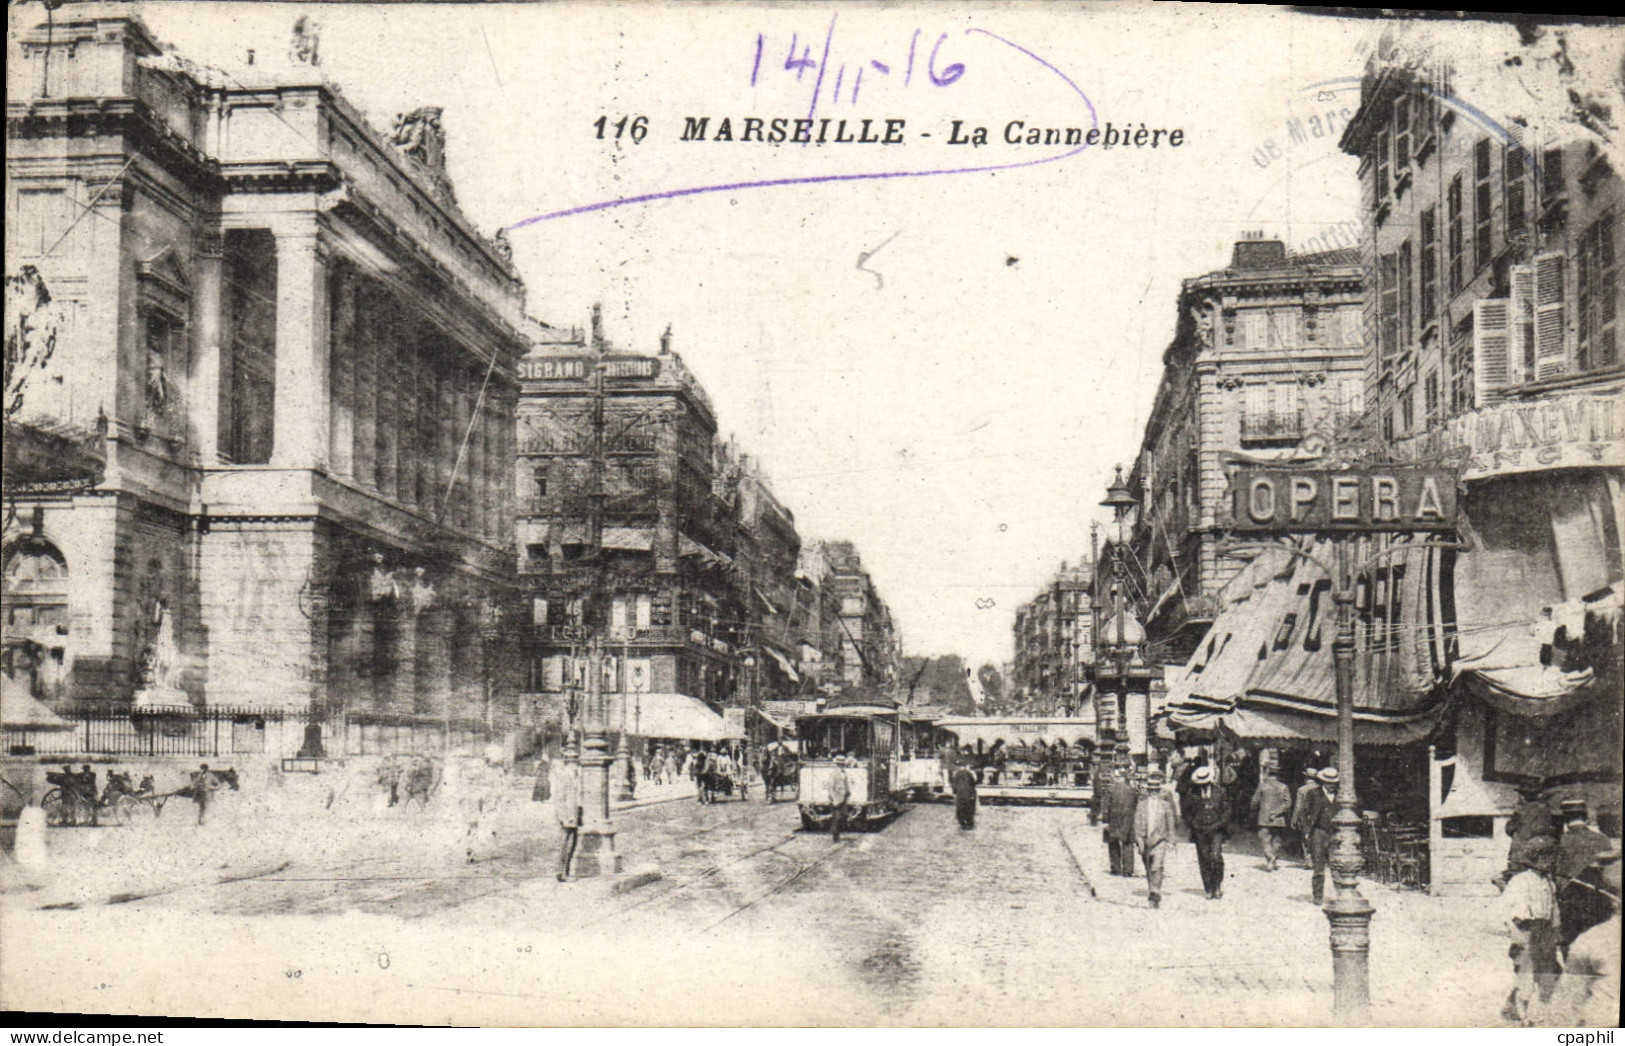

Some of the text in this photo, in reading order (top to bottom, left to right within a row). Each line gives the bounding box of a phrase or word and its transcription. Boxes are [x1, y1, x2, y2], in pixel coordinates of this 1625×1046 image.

[593, 116, 651, 144] 116
[680, 118, 906, 145] MARSEILLE
[947, 119, 989, 146] La
[1004, 118, 1186, 147] Cannebière
[1247, 475, 1446, 524] OPERA
